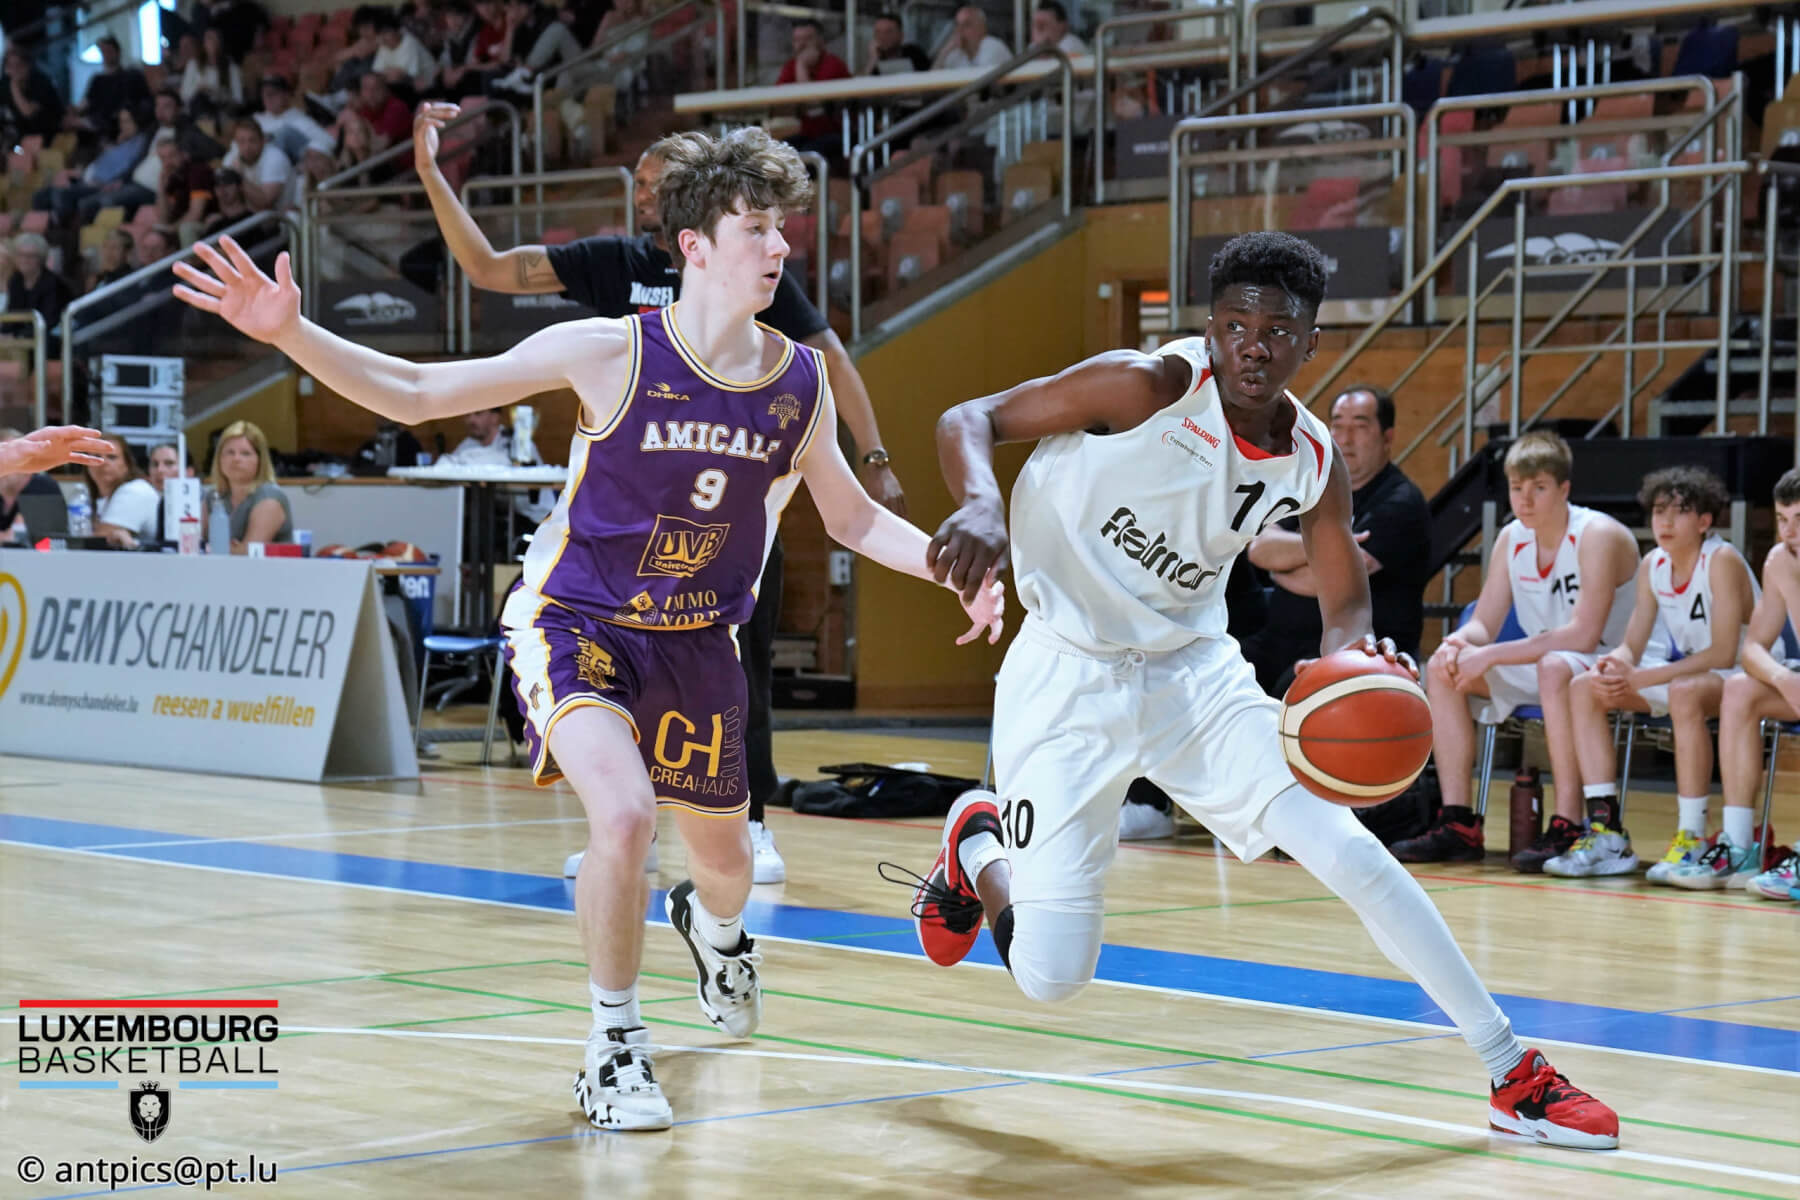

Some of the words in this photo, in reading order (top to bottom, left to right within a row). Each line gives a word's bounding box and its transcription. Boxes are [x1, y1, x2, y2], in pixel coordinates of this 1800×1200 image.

[647, 390, 691, 401] DHIKA
[1181, 416, 1222, 449] SPALDING
[690, 468, 729, 512] 9
[663, 589, 718, 612] IMMO
[1690, 592, 1708, 625] 4
[29, 597, 336, 680] DEMYSCHANDELER
[19, 690, 139, 714] www.demyschandeler.lu
[152, 693, 209, 720] reesen
[211, 699, 223, 721] a
[227, 695, 316, 729] wuelfillen
[650, 765, 740, 797] CREAHAUS
[1001, 799, 1035, 850] 10
